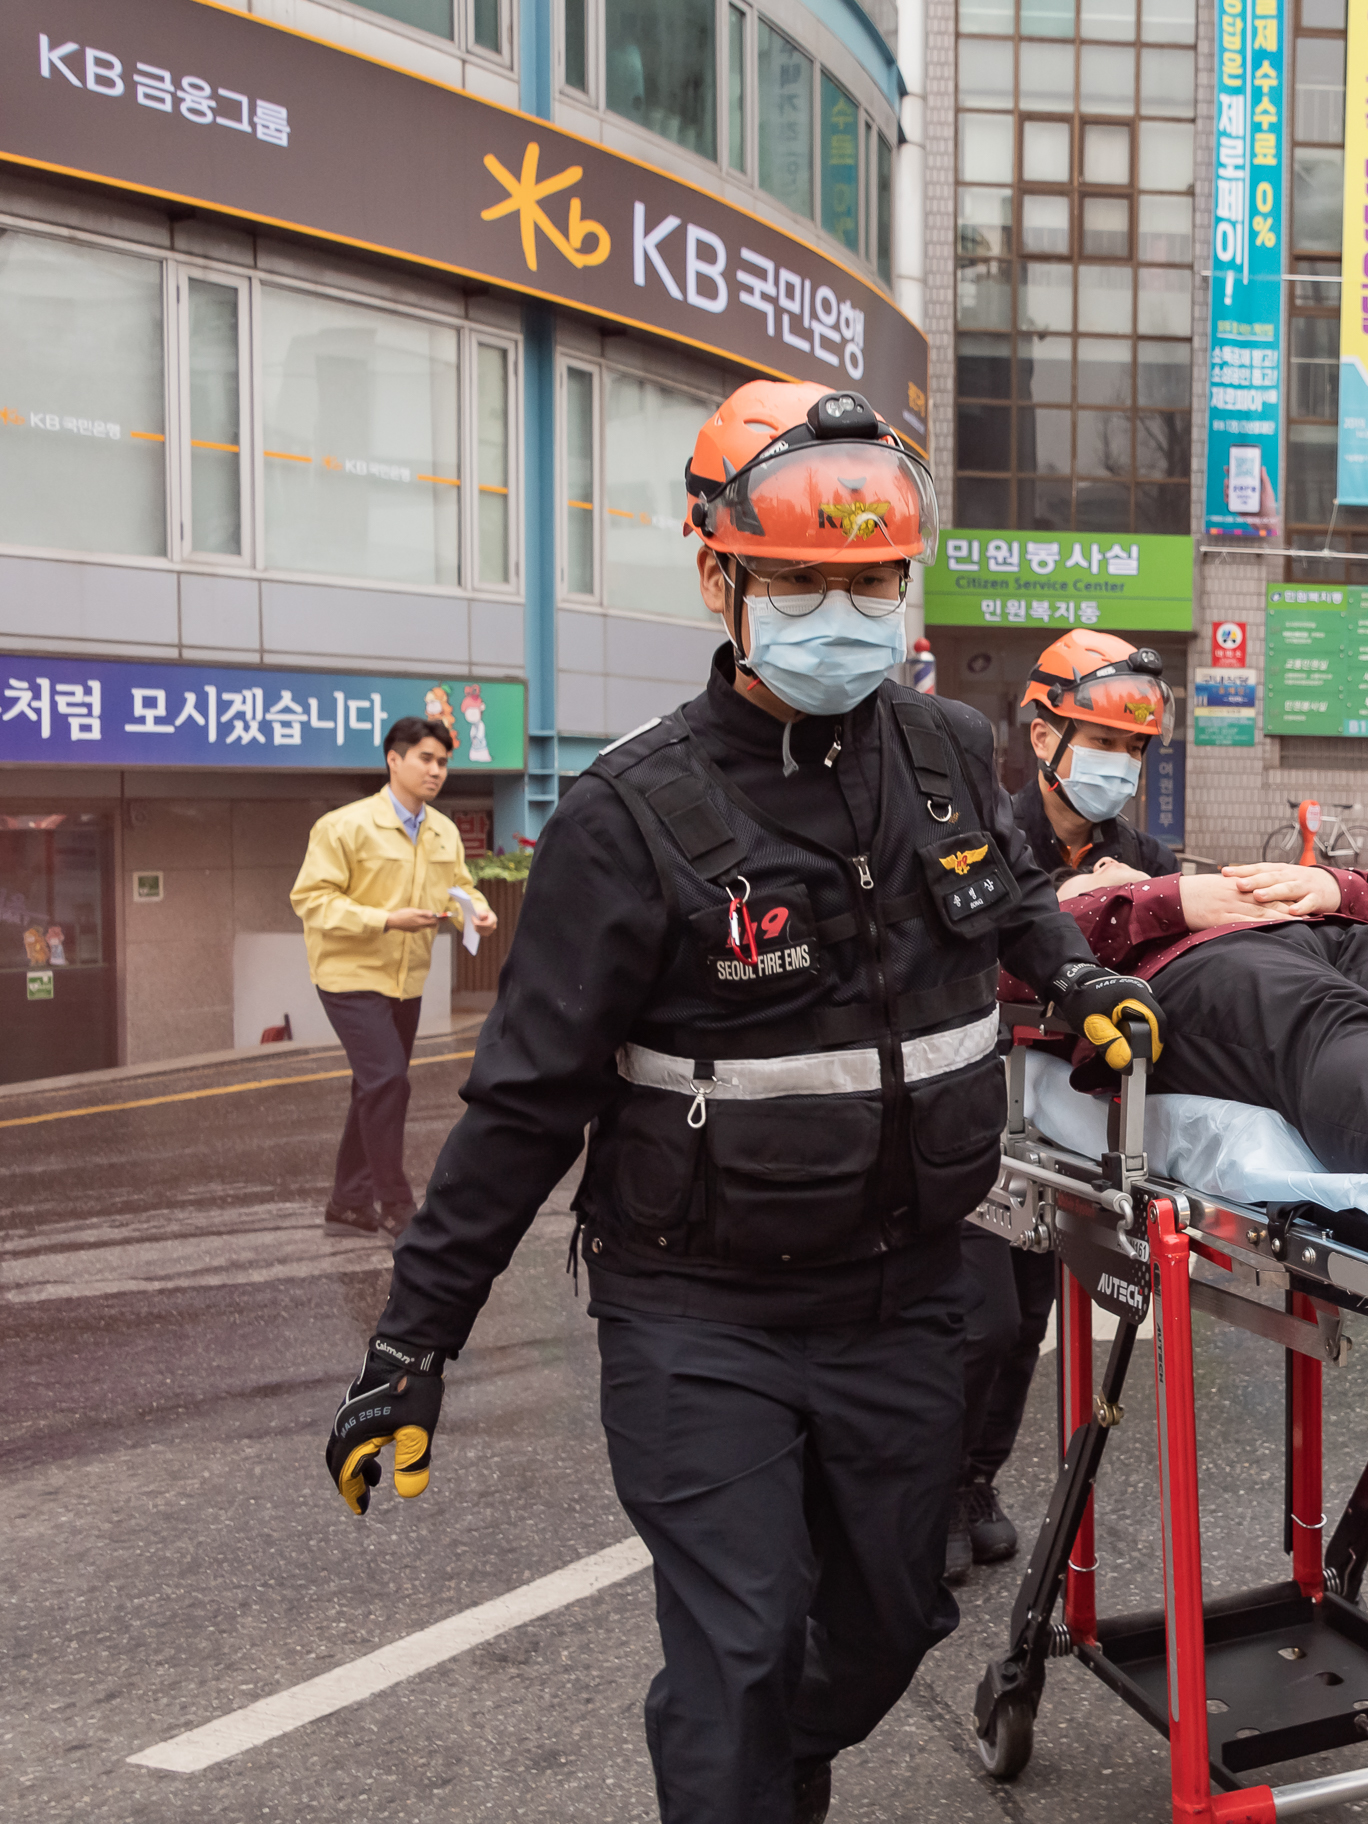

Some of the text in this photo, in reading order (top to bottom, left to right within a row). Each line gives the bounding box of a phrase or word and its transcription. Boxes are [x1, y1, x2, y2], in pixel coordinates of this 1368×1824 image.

[1252, 60, 1278, 167] 수수료
[1252, 180, 1277, 249] 0%
[946, 538, 1140, 576] 민원봉사실
[955, 575, 1125, 593] Citizen Service Center
[981, 599, 1101, 625] 민원복지동
[0, 677, 388, 747] 처럼 모시겠습니다
[716, 944, 811, 981] SEOUL FIRE EMS
[1097, 1272, 1143, 1309] AUTECH
[1156, 1322, 1164, 1384] AUTECH
[340, 1406, 392, 1439] MAG 2956
